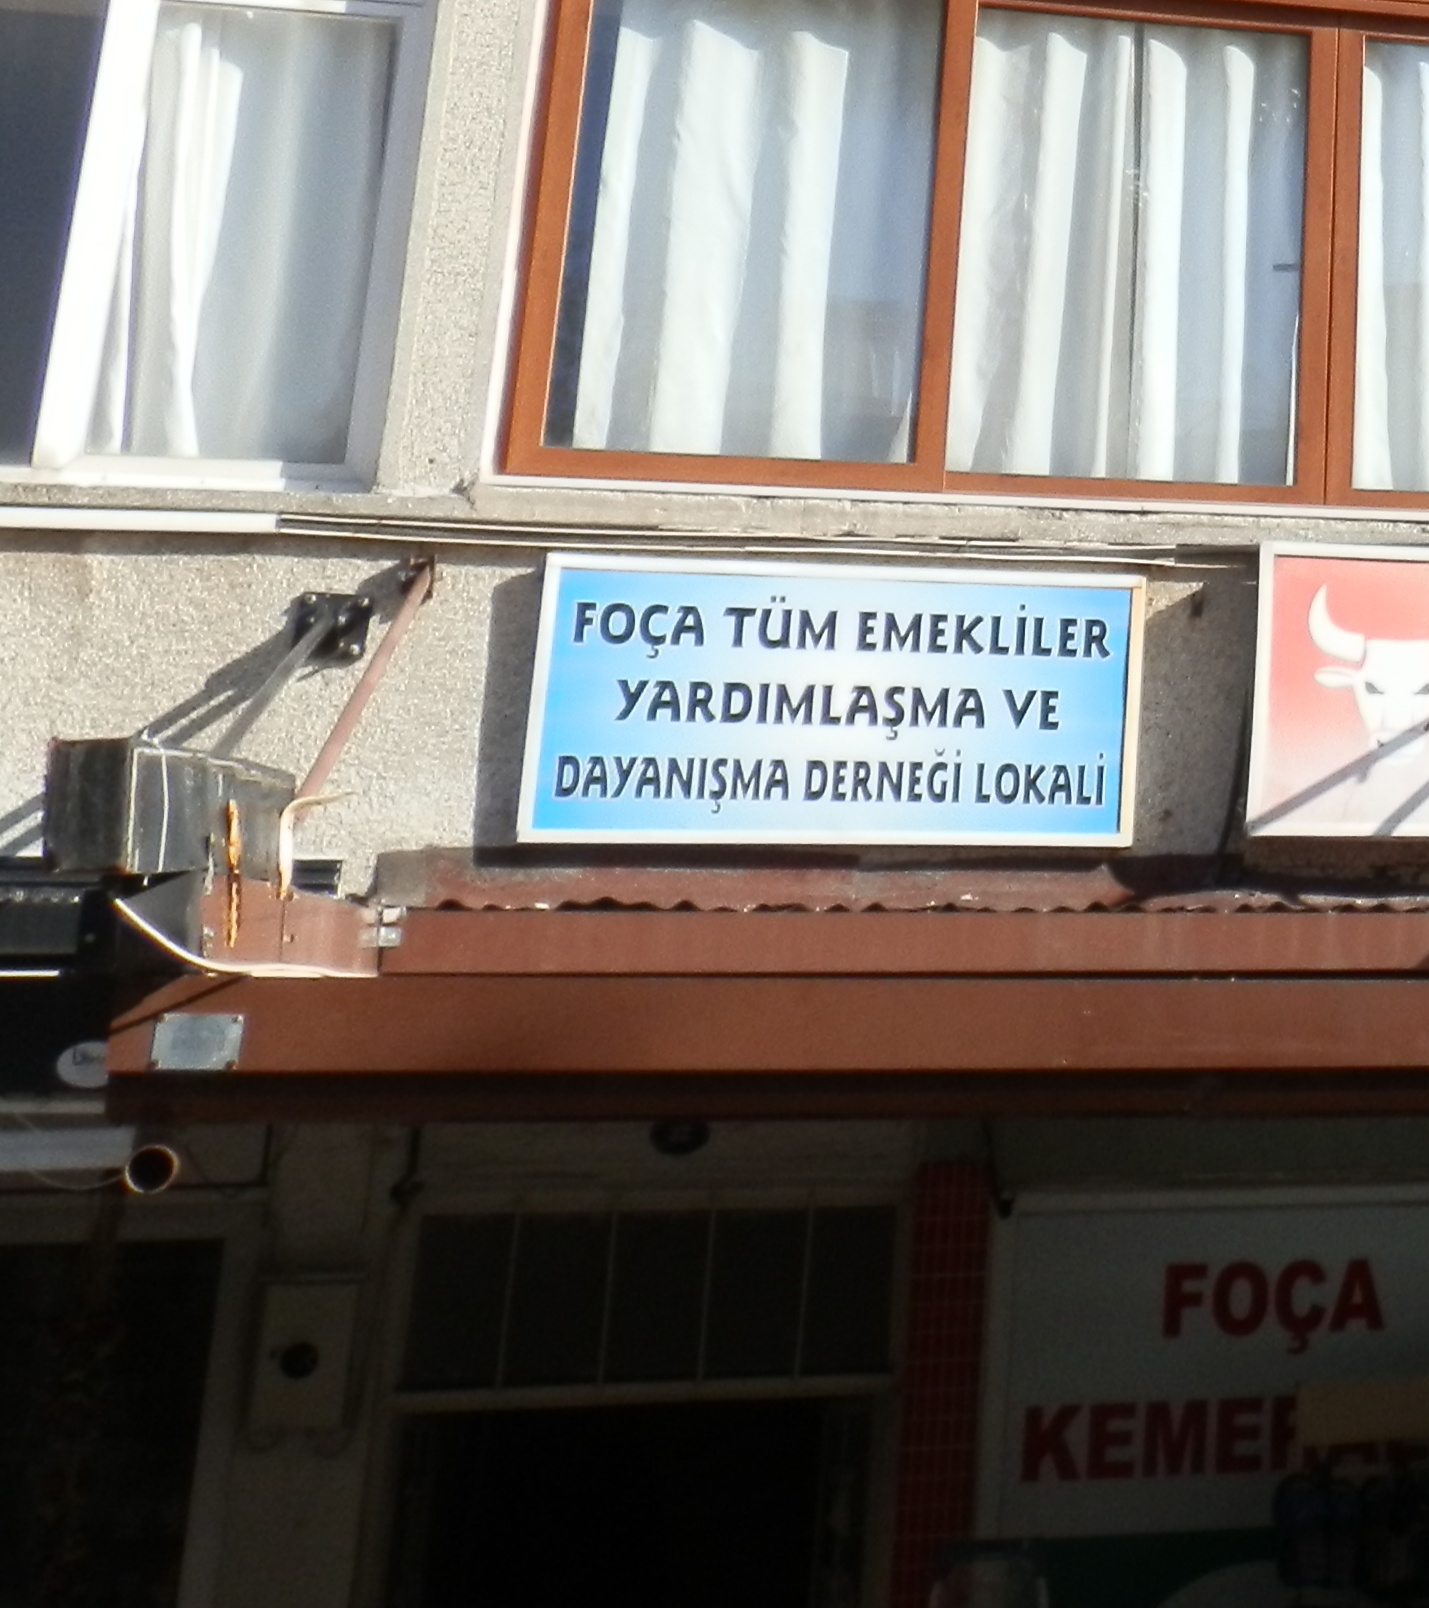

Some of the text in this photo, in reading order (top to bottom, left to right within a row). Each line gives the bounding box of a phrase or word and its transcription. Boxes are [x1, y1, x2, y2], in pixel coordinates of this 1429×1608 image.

[572, 594, 1111, 660] FOÇA TÜM EMEKLİLER
[614, 678, 1061, 741] YARDIMLAŞMA VE
[554, 747, 1107, 814] DAYANIŞMA DERNEĞİ LOKALİ
[1162, 1258, 1386, 1355] FOÇA
